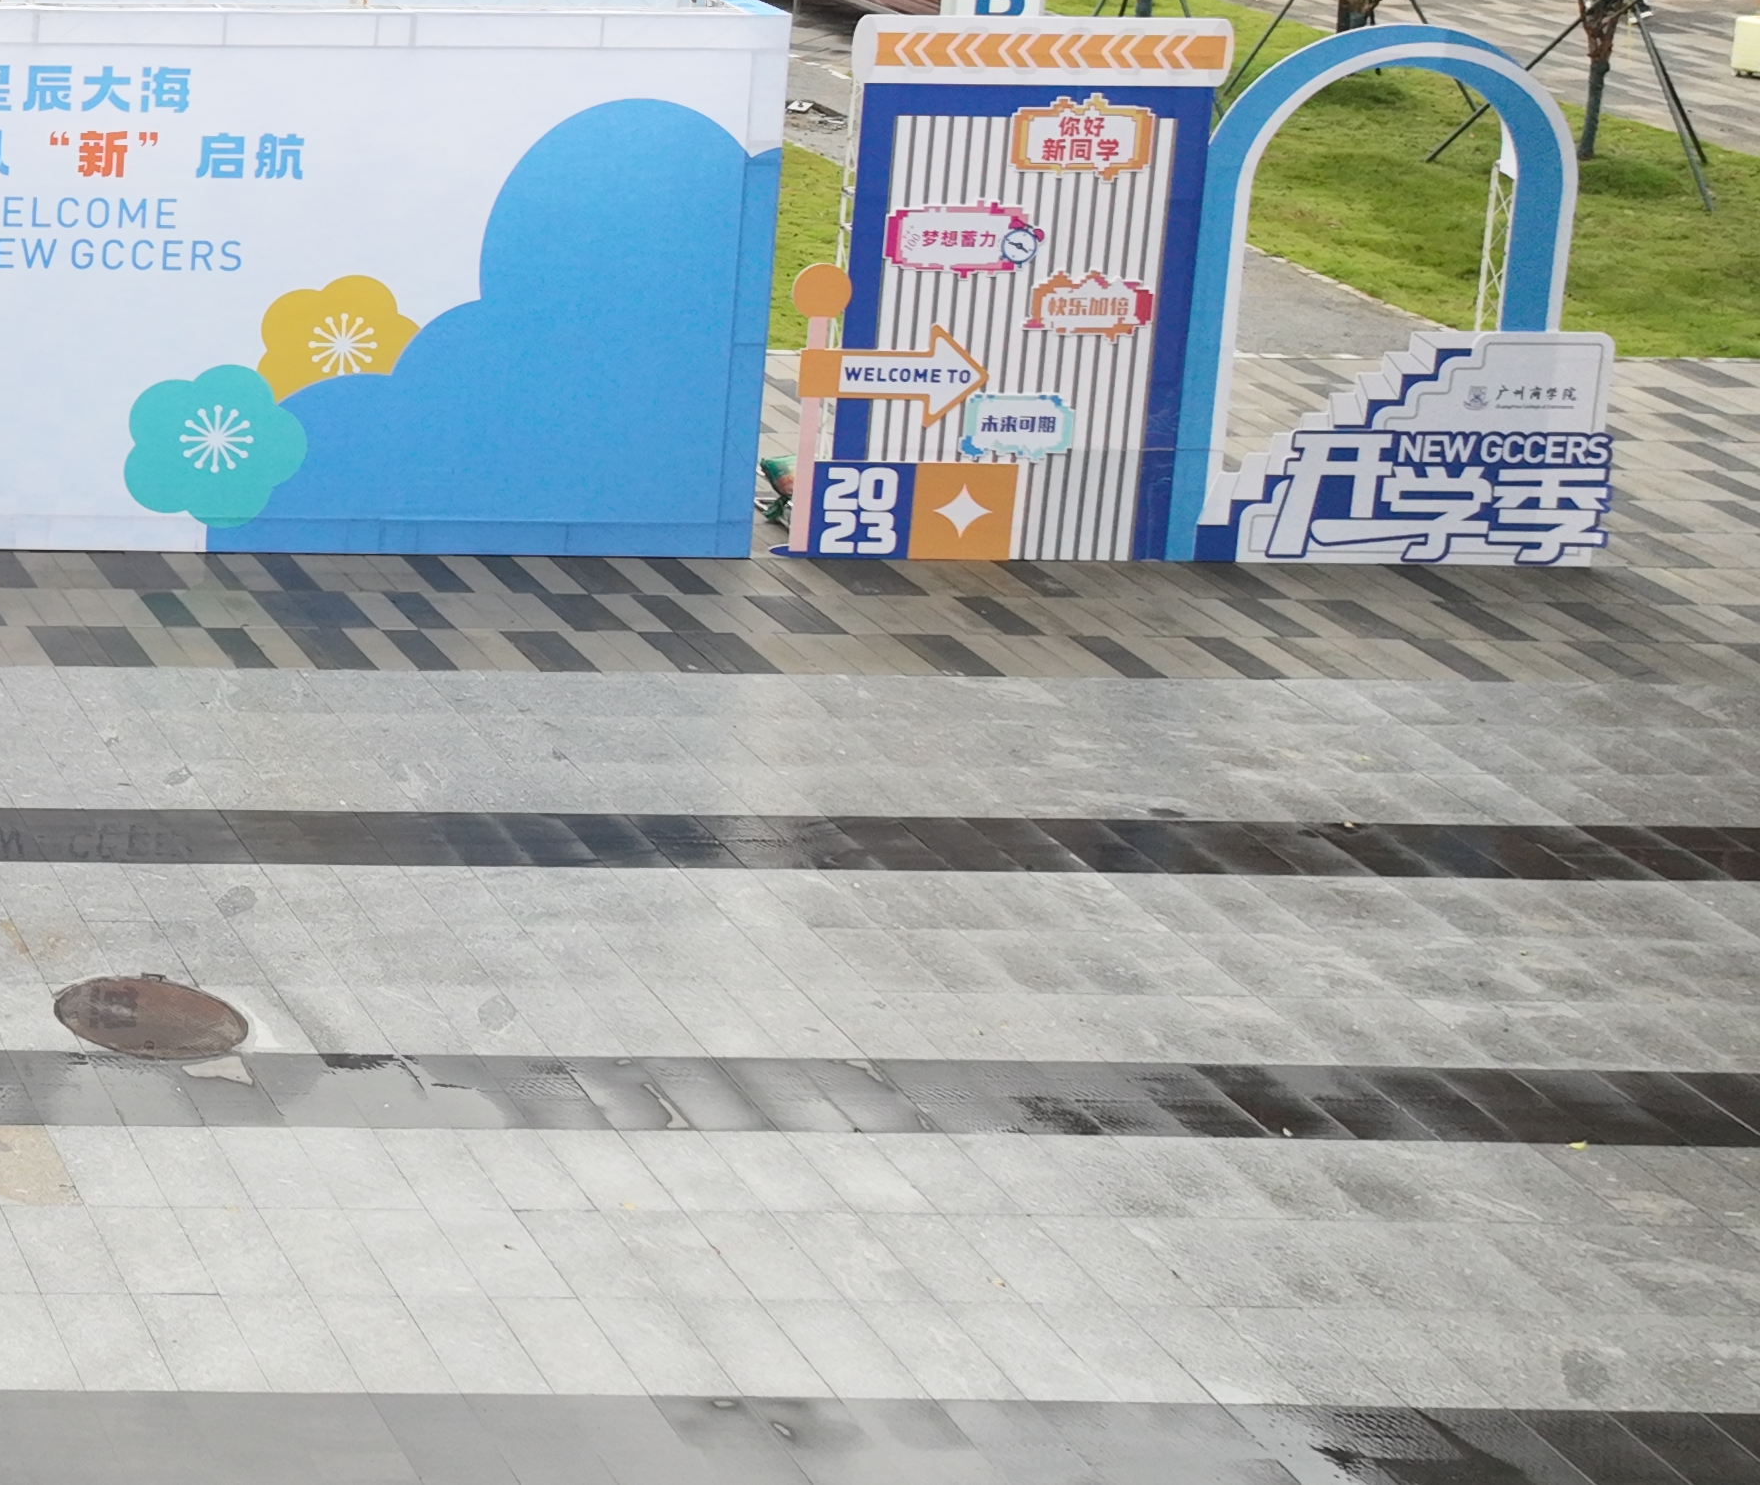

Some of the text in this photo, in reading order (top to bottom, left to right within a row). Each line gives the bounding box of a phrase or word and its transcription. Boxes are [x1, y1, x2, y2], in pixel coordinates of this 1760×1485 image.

[1058, 117, 1106, 137] 你好
[1041, 138, 1121, 162] 新同学
[921, 229, 997, 249] 梦想蓄力
[69, 238, 244, 273] GCCERS
[1047, 295, 1131, 317] 快乐加倍
[843, 367, 972, 385] WELCOME TO
[1495, 384, 1578, 401] 广州商学院
[980, 415, 1057, 434] 未来可期
[1397, 434, 1612, 467] NEW GCCERS
[1269, 433, 1612, 564] 开学季
